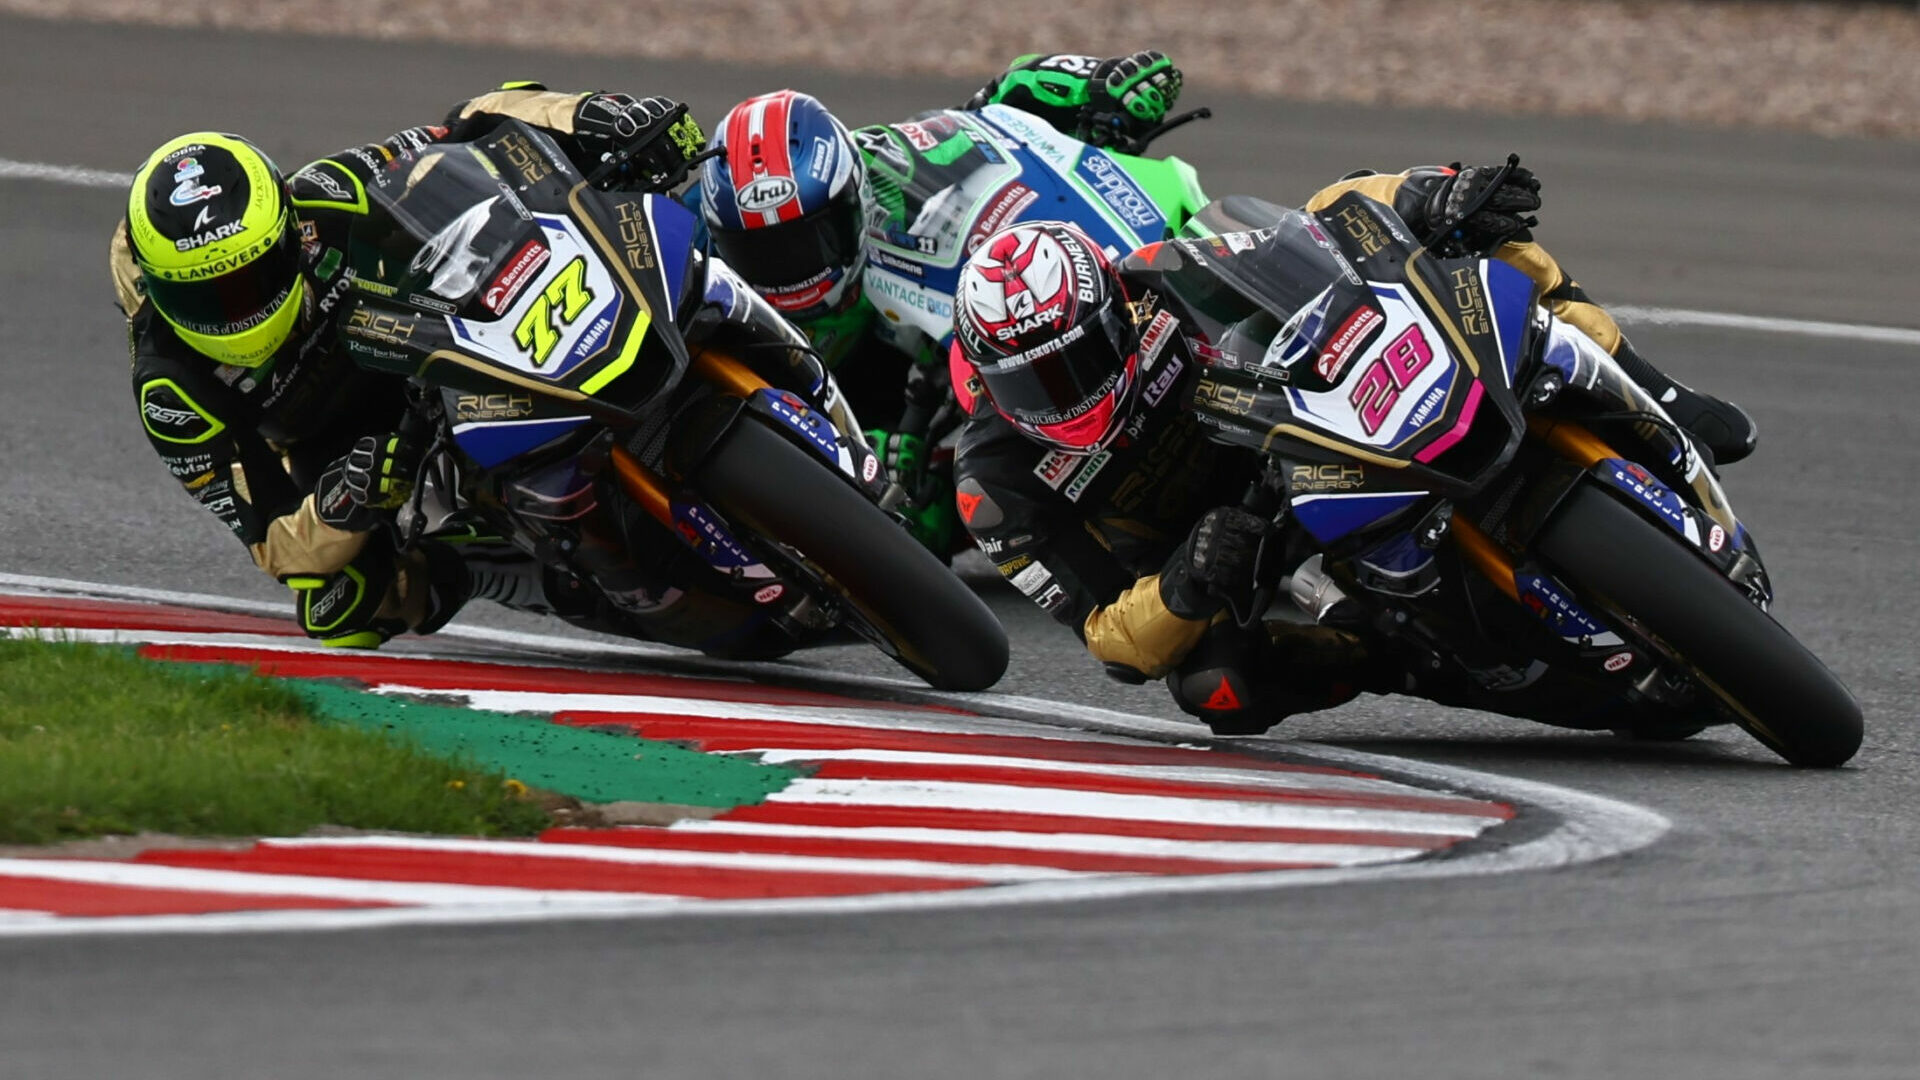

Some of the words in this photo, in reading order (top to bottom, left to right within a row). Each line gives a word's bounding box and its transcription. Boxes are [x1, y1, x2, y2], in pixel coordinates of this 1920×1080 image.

[163, 144, 206, 163] COBRA
[744, 180, 788, 203] Arai
[980, 185, 1027, 233] Bennetts
[175, 219, 244, 251] SHARK
[615, 203, 644, 270] RICH
[631, 200, 654, 268] ENERGY
[178, 245, 261, 281] LANGVER
[501, 244, 542, 286] Bennetts
[1055, 231, 1094, 303] BURNELL
[230, 288, 289, 332] DISTINCTION
[319, 266, 358, 313] RYDE
[512, 254, 595, 367] 77
[868, 273, 925, 310] VANTAGE
[1451, 268, 1480, 336] RICH
[1466, 266, 1489, 334] ENERGY
[349, 308, 415, 338] RICH
[574, 318, 611, 358] YAMAHA
[996, 303, 1064, 340] SHARK
[1140, 312, 1172, 353] YAMAHA
[1332, 309, 1374, 352] Bennetts
[997, 325, 1085, 370] WWW.ESKUTA.COM
[1021, 412, 1063, 425] WATCHES
[1063, 410, 1072, 421] of
[1073, 370, 1119, 417] DISTINCTION
[1142, 353, 1184, 408] Ray
[1195, 378, 1256, 408] RICH
[1348, 322, 1434, 437] 28
[144, 402, 200, 426] RST
[456, 409, 533, 420] ENERGY
[457, 394, 532, 411] RICH
[1409, 387, 1447, 428] YAMAHA
[771, 401, 835, 452] PIRELLI
[1291, 464, 1364, 480] RICH
[1291, 480, 1365, 491] ENERGY
[1616, 471, 1681, 521] PIRELLI
[688, 506, 749, 562] PIRELLI
[311, 575, 349, 624] RST
[1532, 578, 1596, 631] PIRELLI
